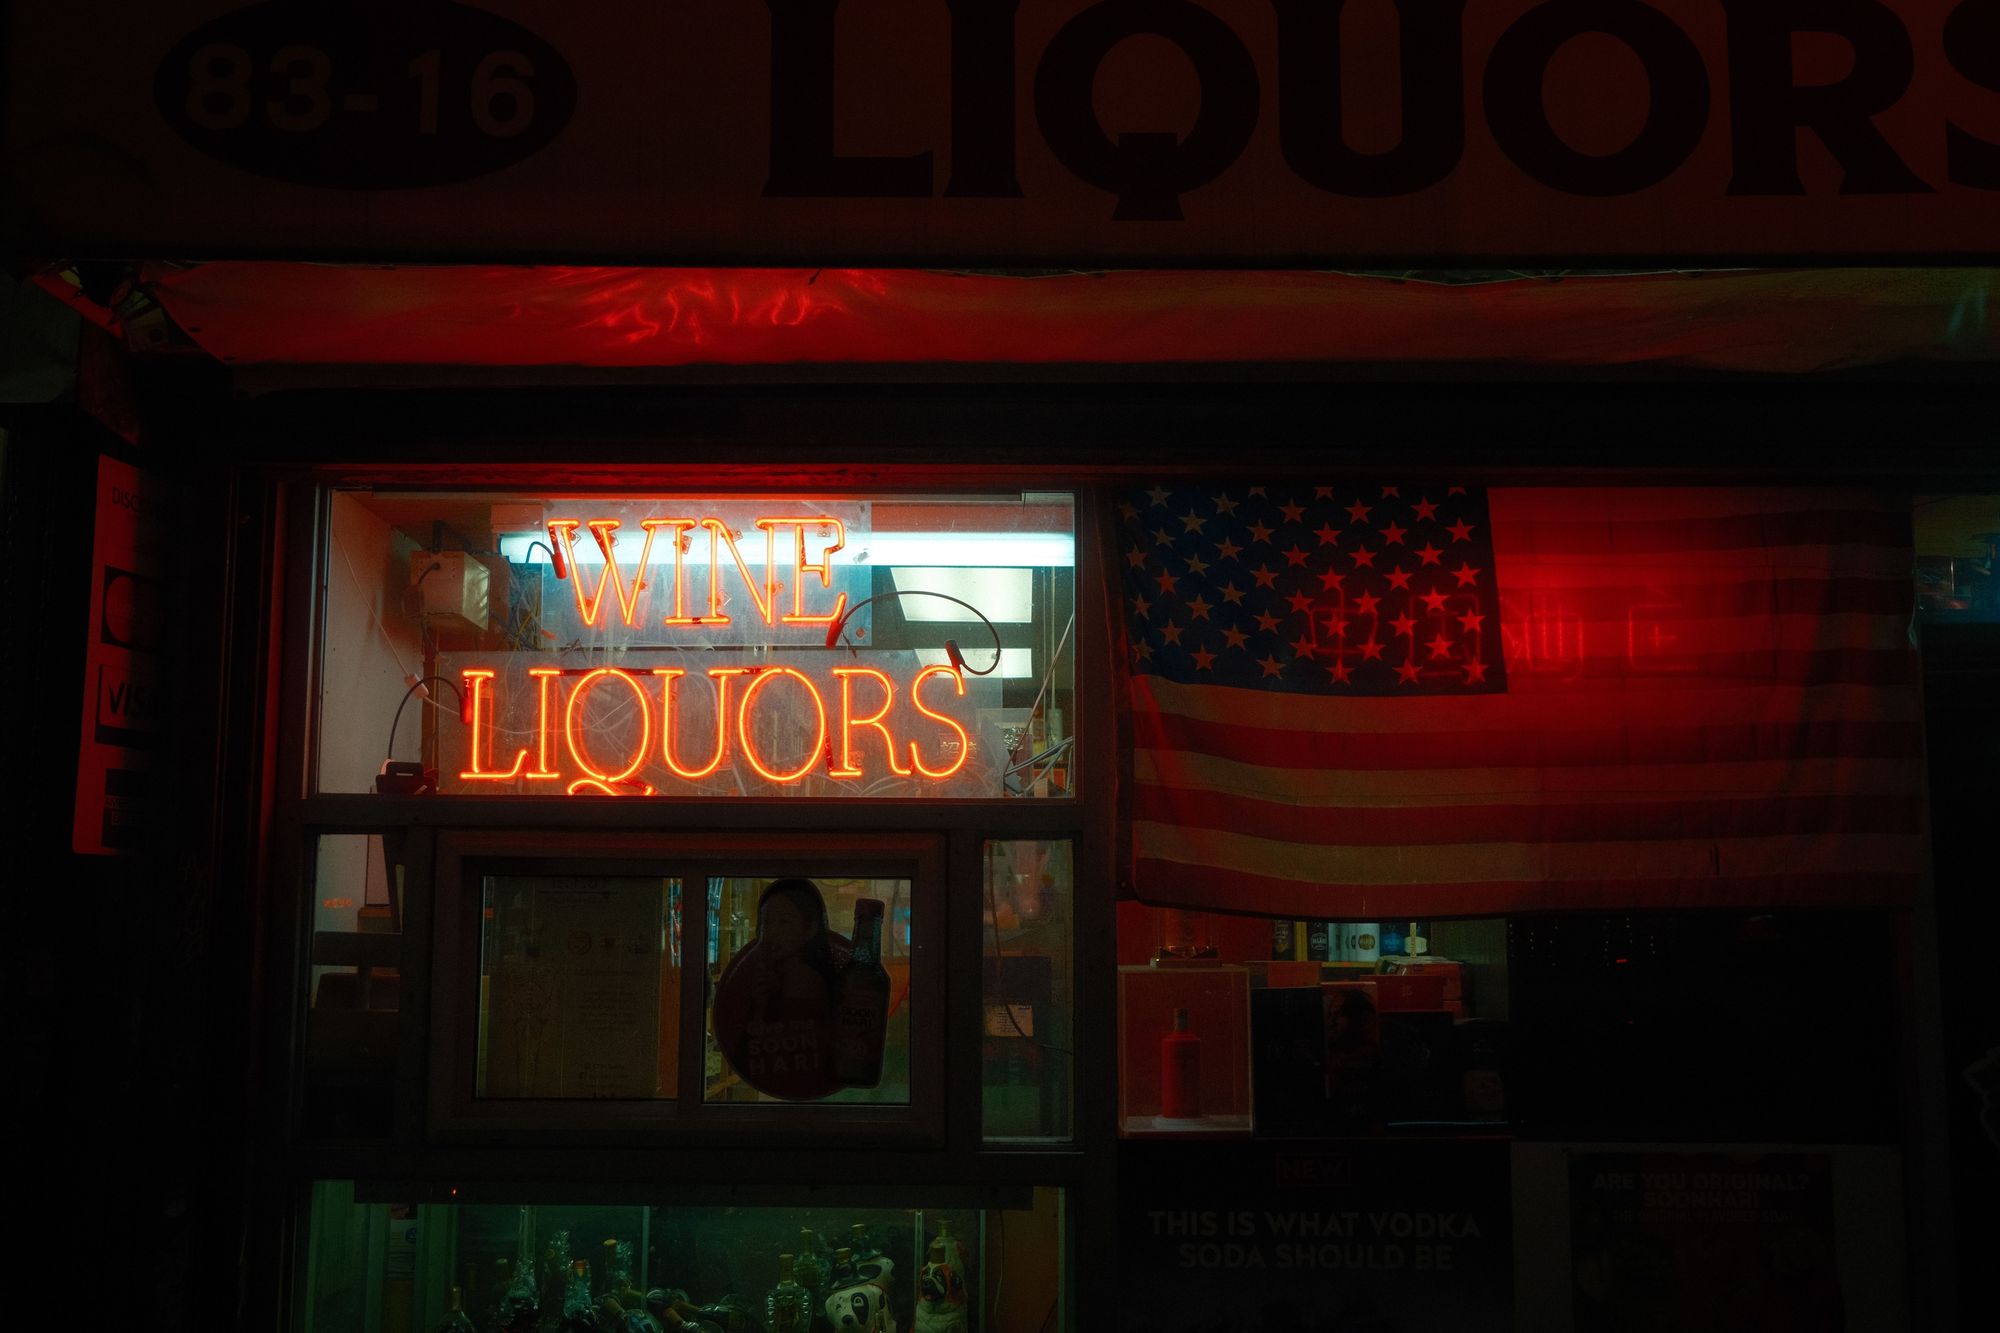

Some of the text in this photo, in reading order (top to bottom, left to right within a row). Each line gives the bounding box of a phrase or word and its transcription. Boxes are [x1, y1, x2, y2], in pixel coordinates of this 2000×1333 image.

[185, 42, 537, 137] 83-16
[547, 516, 847, 626] WINE
[108, 682, 147, 720] VIS
[459, 662, 969, 796] LIQUORS
[747, 1034, 818, 1056] SOON
[748, 1053, 820, 1074] HARI
[1282, 1158, 1345, 1182] NEW
[1591, 1172, 1634, 1192] ARE
[1640, 1172, 1688, 1191] YOU
[1147, 1210, 1481, 1239] THIS IS WHAT VODKA
[1177, 1242, 1456, 1271] SODA SHOULD BE
